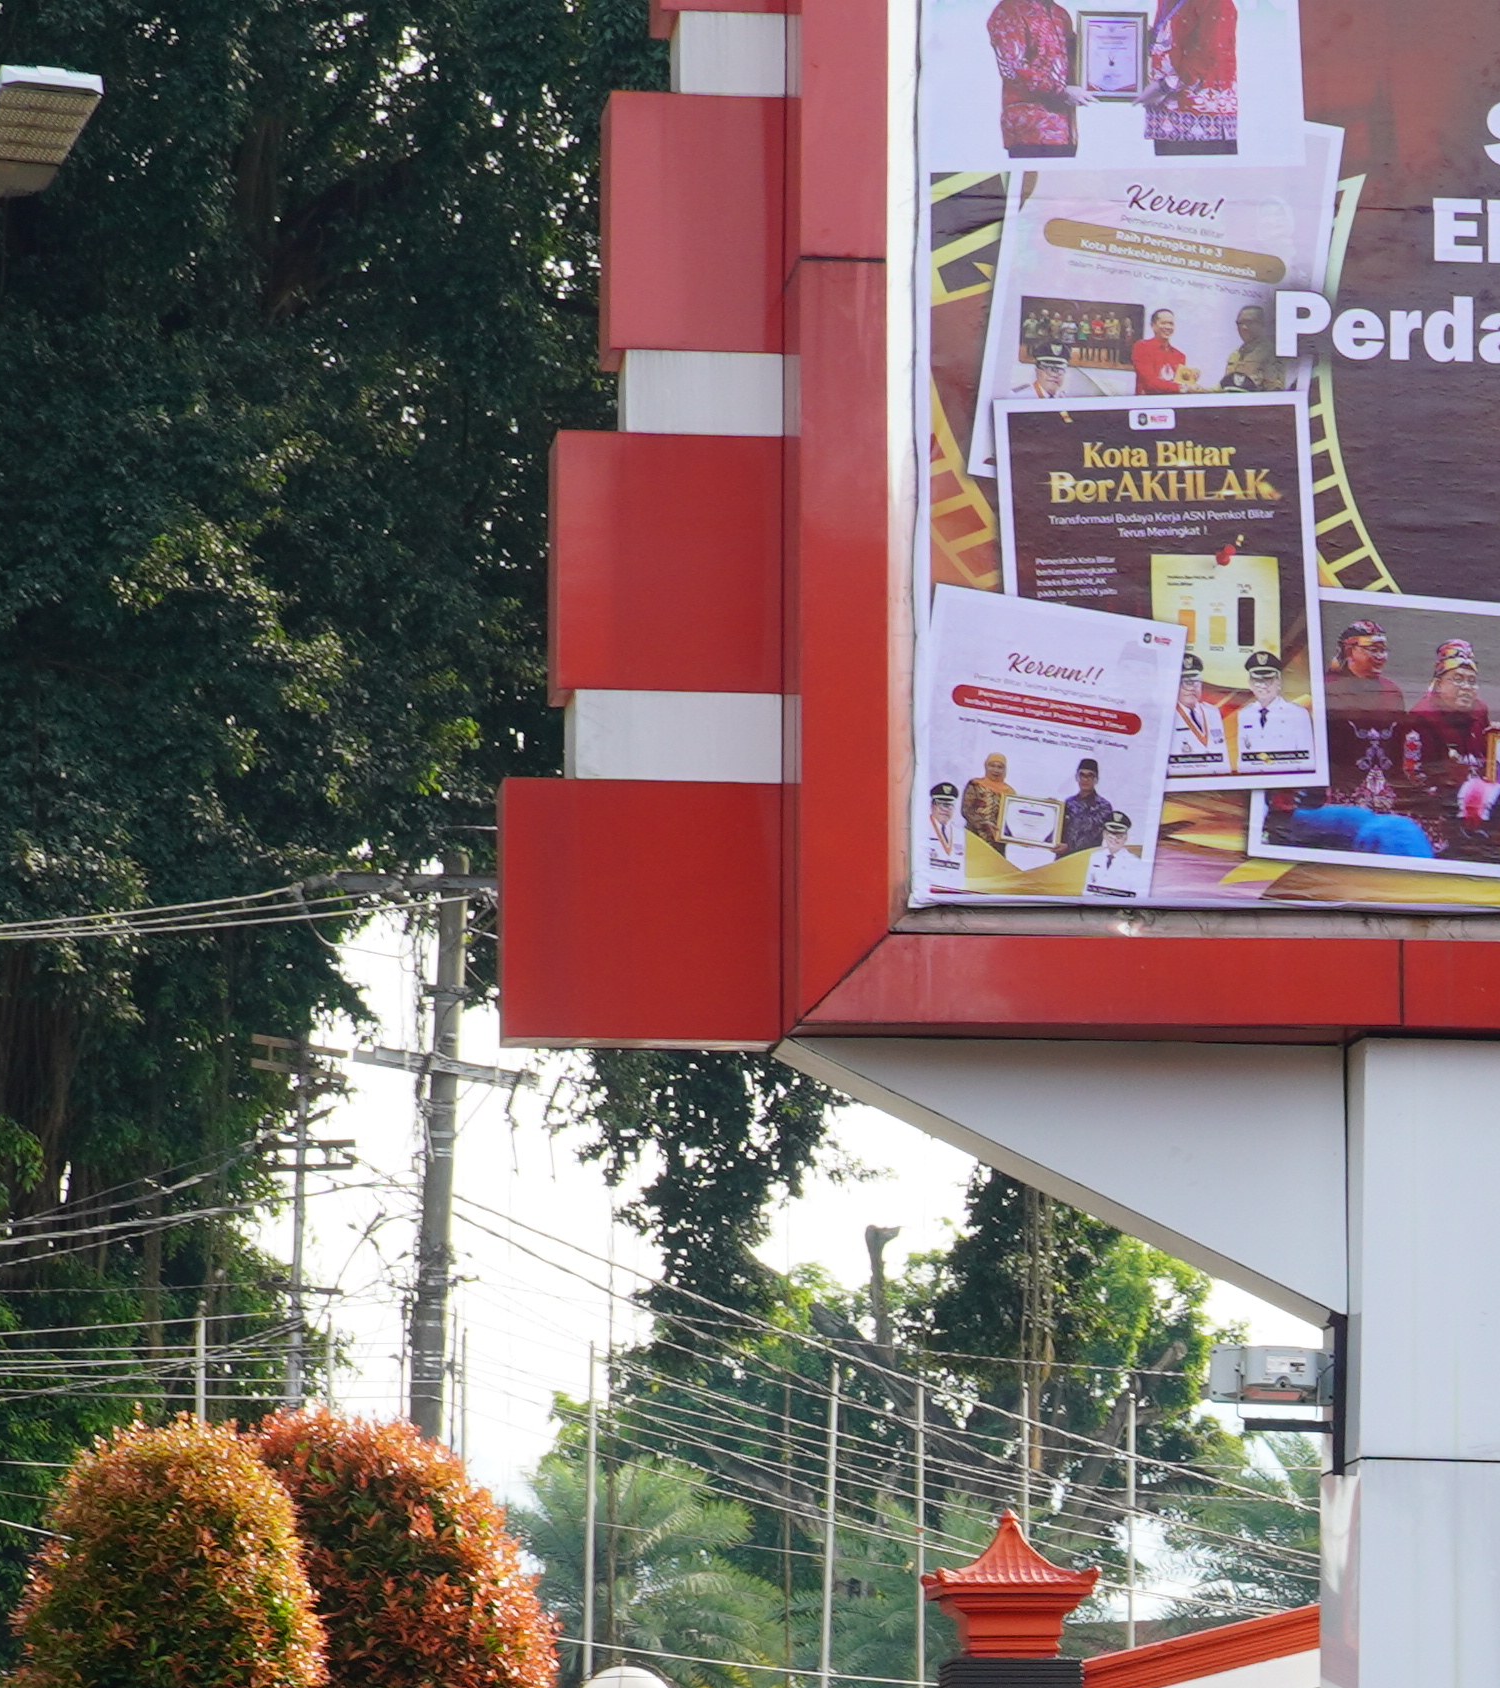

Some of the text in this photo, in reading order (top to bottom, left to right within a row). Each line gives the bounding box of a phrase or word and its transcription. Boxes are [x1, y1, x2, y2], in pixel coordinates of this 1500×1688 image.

[1127, 184, 1224, 220] Keren!
[1116, 231, 1222, 258] Raih Peringkat ke 3
[1176, 224, 1197, 236] Kota
[1200, 227, 1224, 239] Blitar
[1081, 239, 1106, 252] Kota
[1109, 244, 1186, 266] Berkelanjutan
[1203, 260, 1256, 278] Indonesia
[1082, 440, 1237, 468] Kota Blitar
[1048, 469, 1281, 504] BerAKHLAK
[1048, 509, 1274, 526] Transformasi Budaya Kerja ASN Pemkot Blitar
[1118, 528, 1146, 538] Terus
[1147, 526, 1200, 539] Meningkat
